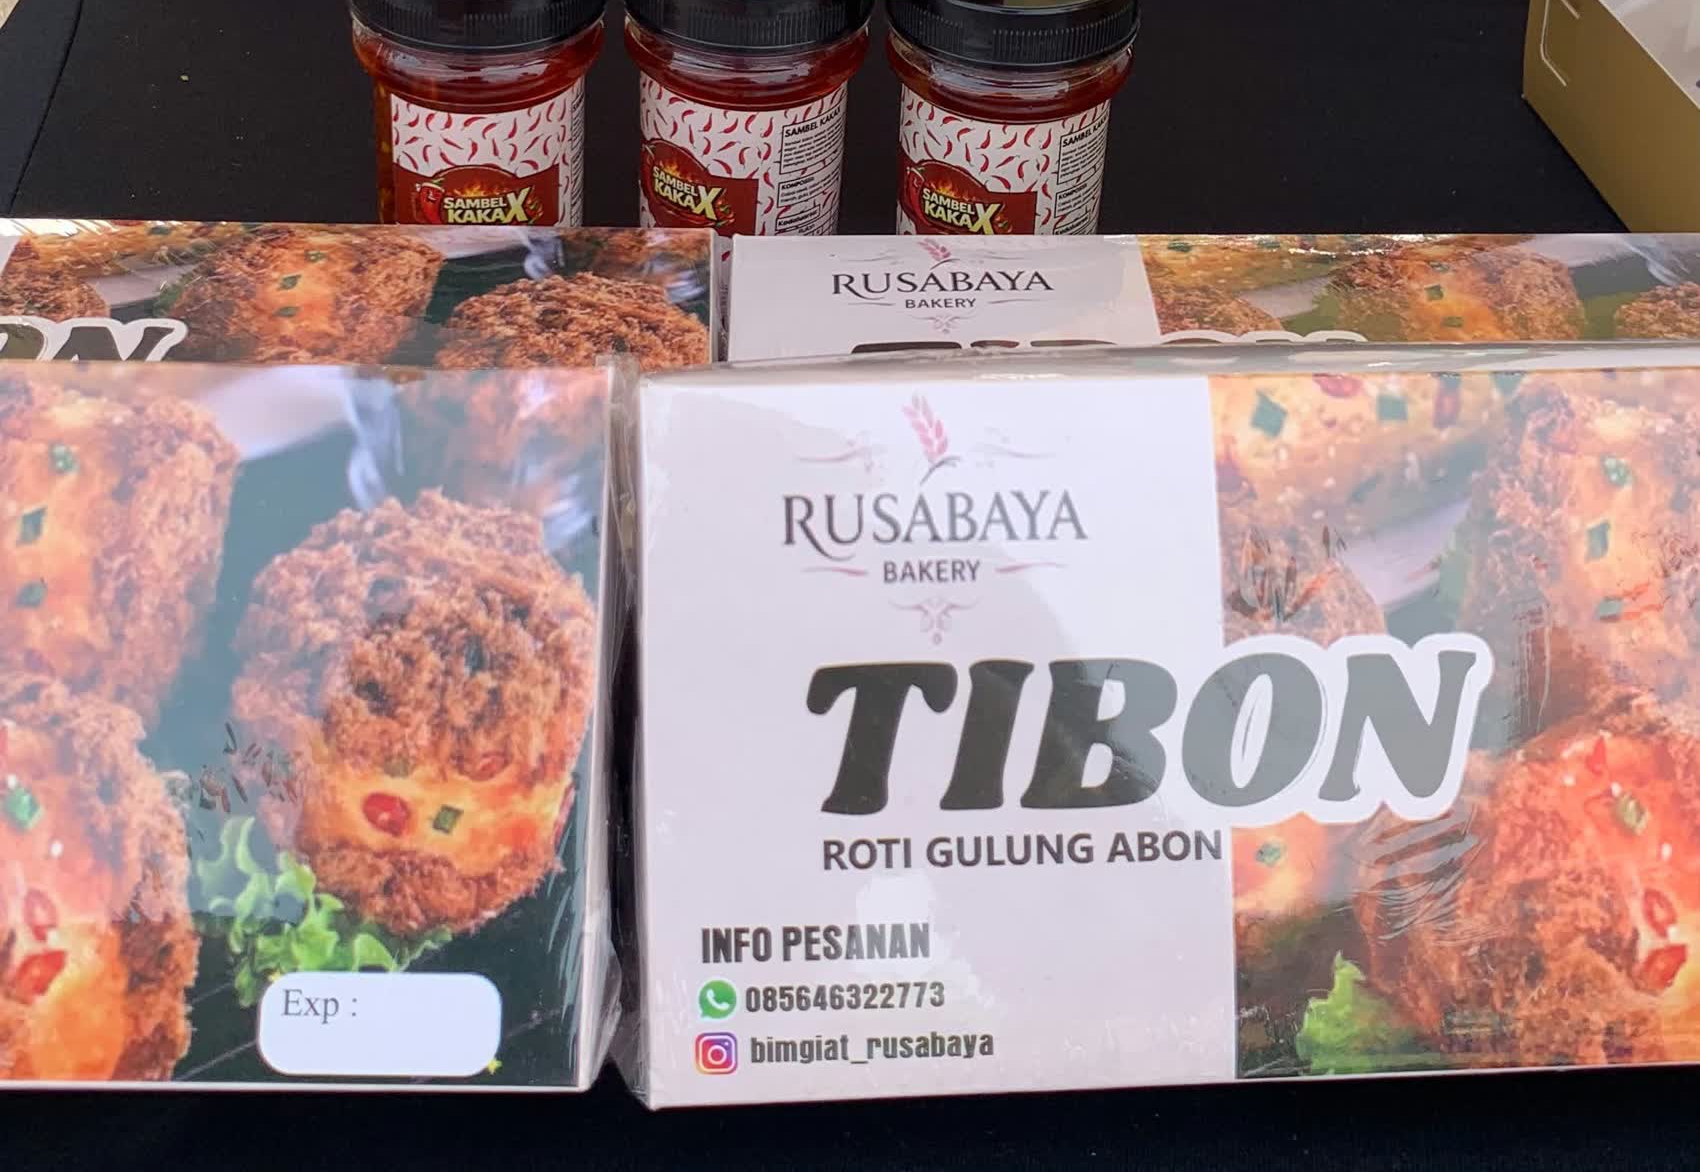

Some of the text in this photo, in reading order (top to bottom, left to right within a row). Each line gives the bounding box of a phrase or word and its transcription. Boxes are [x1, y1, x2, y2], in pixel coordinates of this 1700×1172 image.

[785, 122, 818, 138] SAMBEL
[1062, 129, 1092, 148] SAMBEL
[652, 165, 698, 195] SAMBEL
[443, 197, 507, 209] SAMBEL
[922, 187, 975, 214] SAMBEL
[832, 271, 1055, 300] RUSABAYA
[905, 298, 976, 309] BAKERY
[782, 490, 1088, 561] RUSABAYA
[882, 559, 981, 584] BAKERY
[806, 650, 1478, 815] TIBON
[822, 829, 1223, 870] ROTI GULUNG ABON
[701, 923, 931, 964] INFO PESANAN
[281, 989, 340, 1024] Exp
[745, 981, 946, 1013] 085646322773
[751, 1031, 994, 1065] bimgiat_rusabaya
